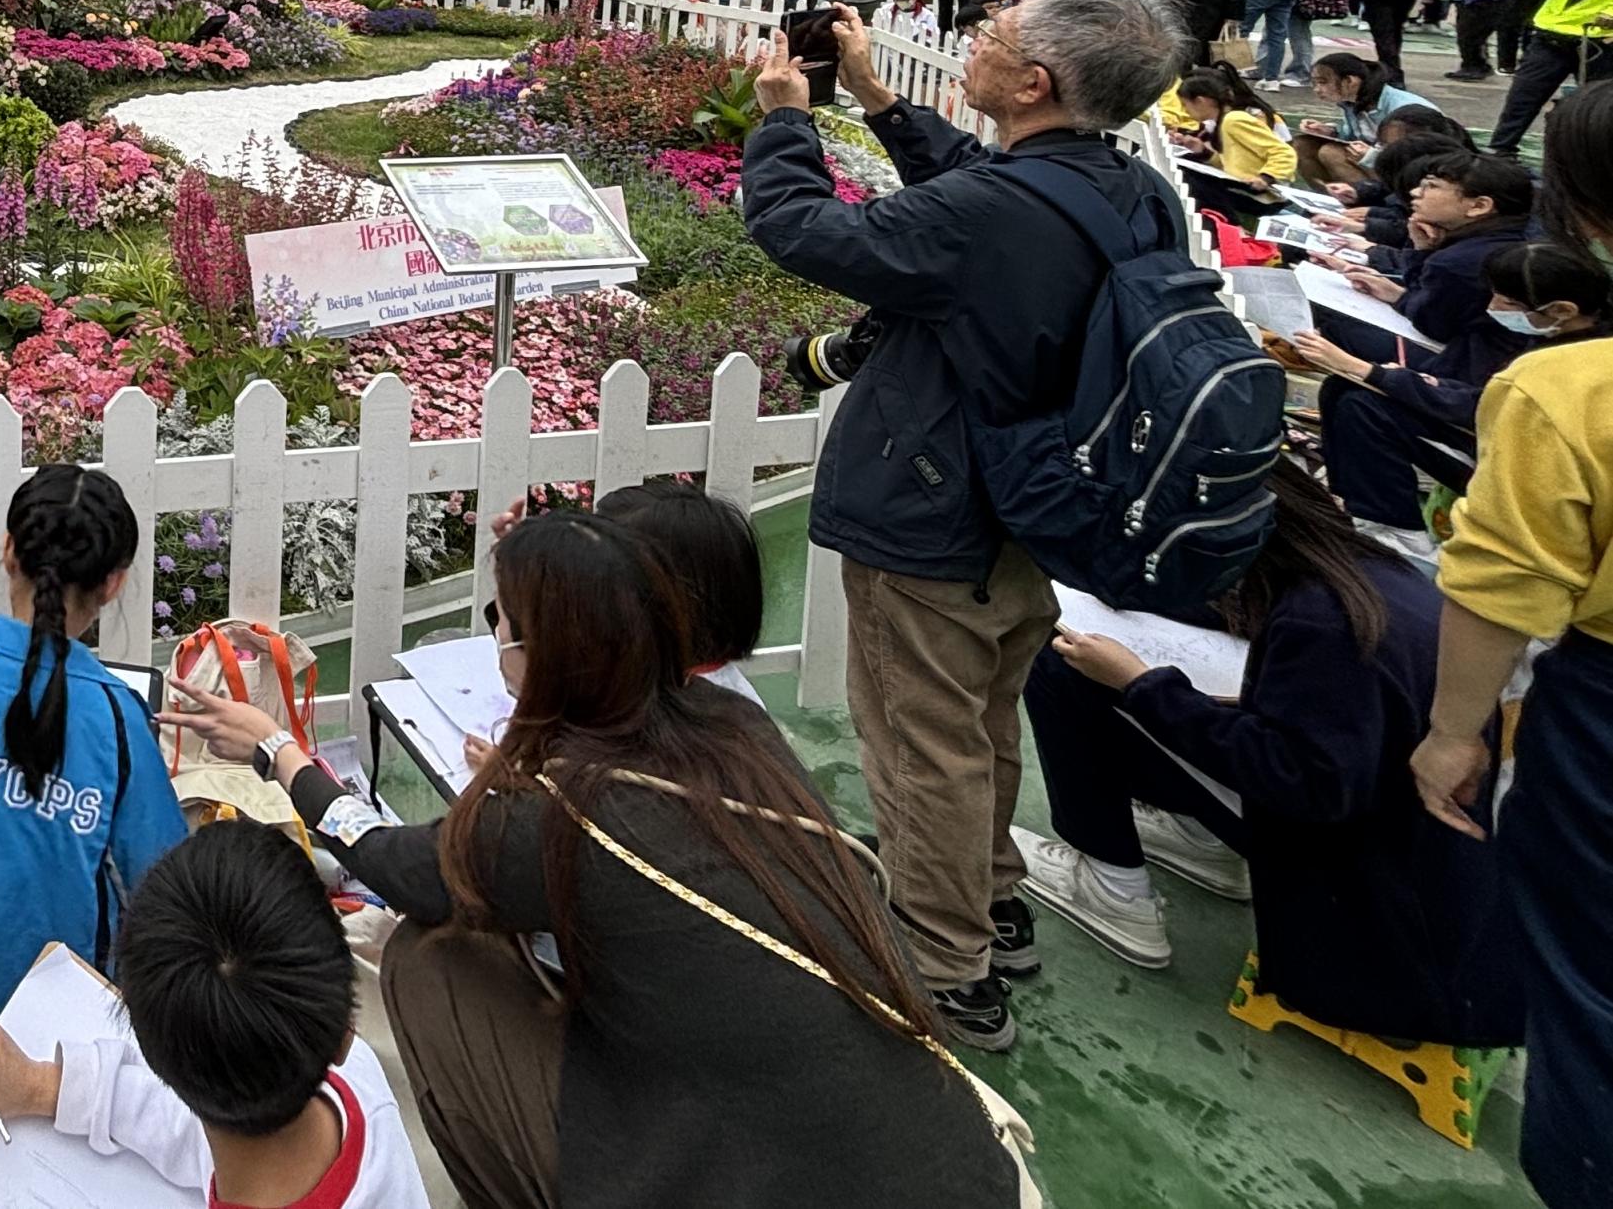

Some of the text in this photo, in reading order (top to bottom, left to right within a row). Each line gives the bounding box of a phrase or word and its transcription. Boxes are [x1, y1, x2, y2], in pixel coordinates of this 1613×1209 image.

[356, 218, 425, 251] 北京市
[326, 295, 364, 311] Beijing
[368, 283, 417, 304] Municipal
[422, 273, 494, 295] Administration
[379, 282, 544, 320] China National Botanic arden
